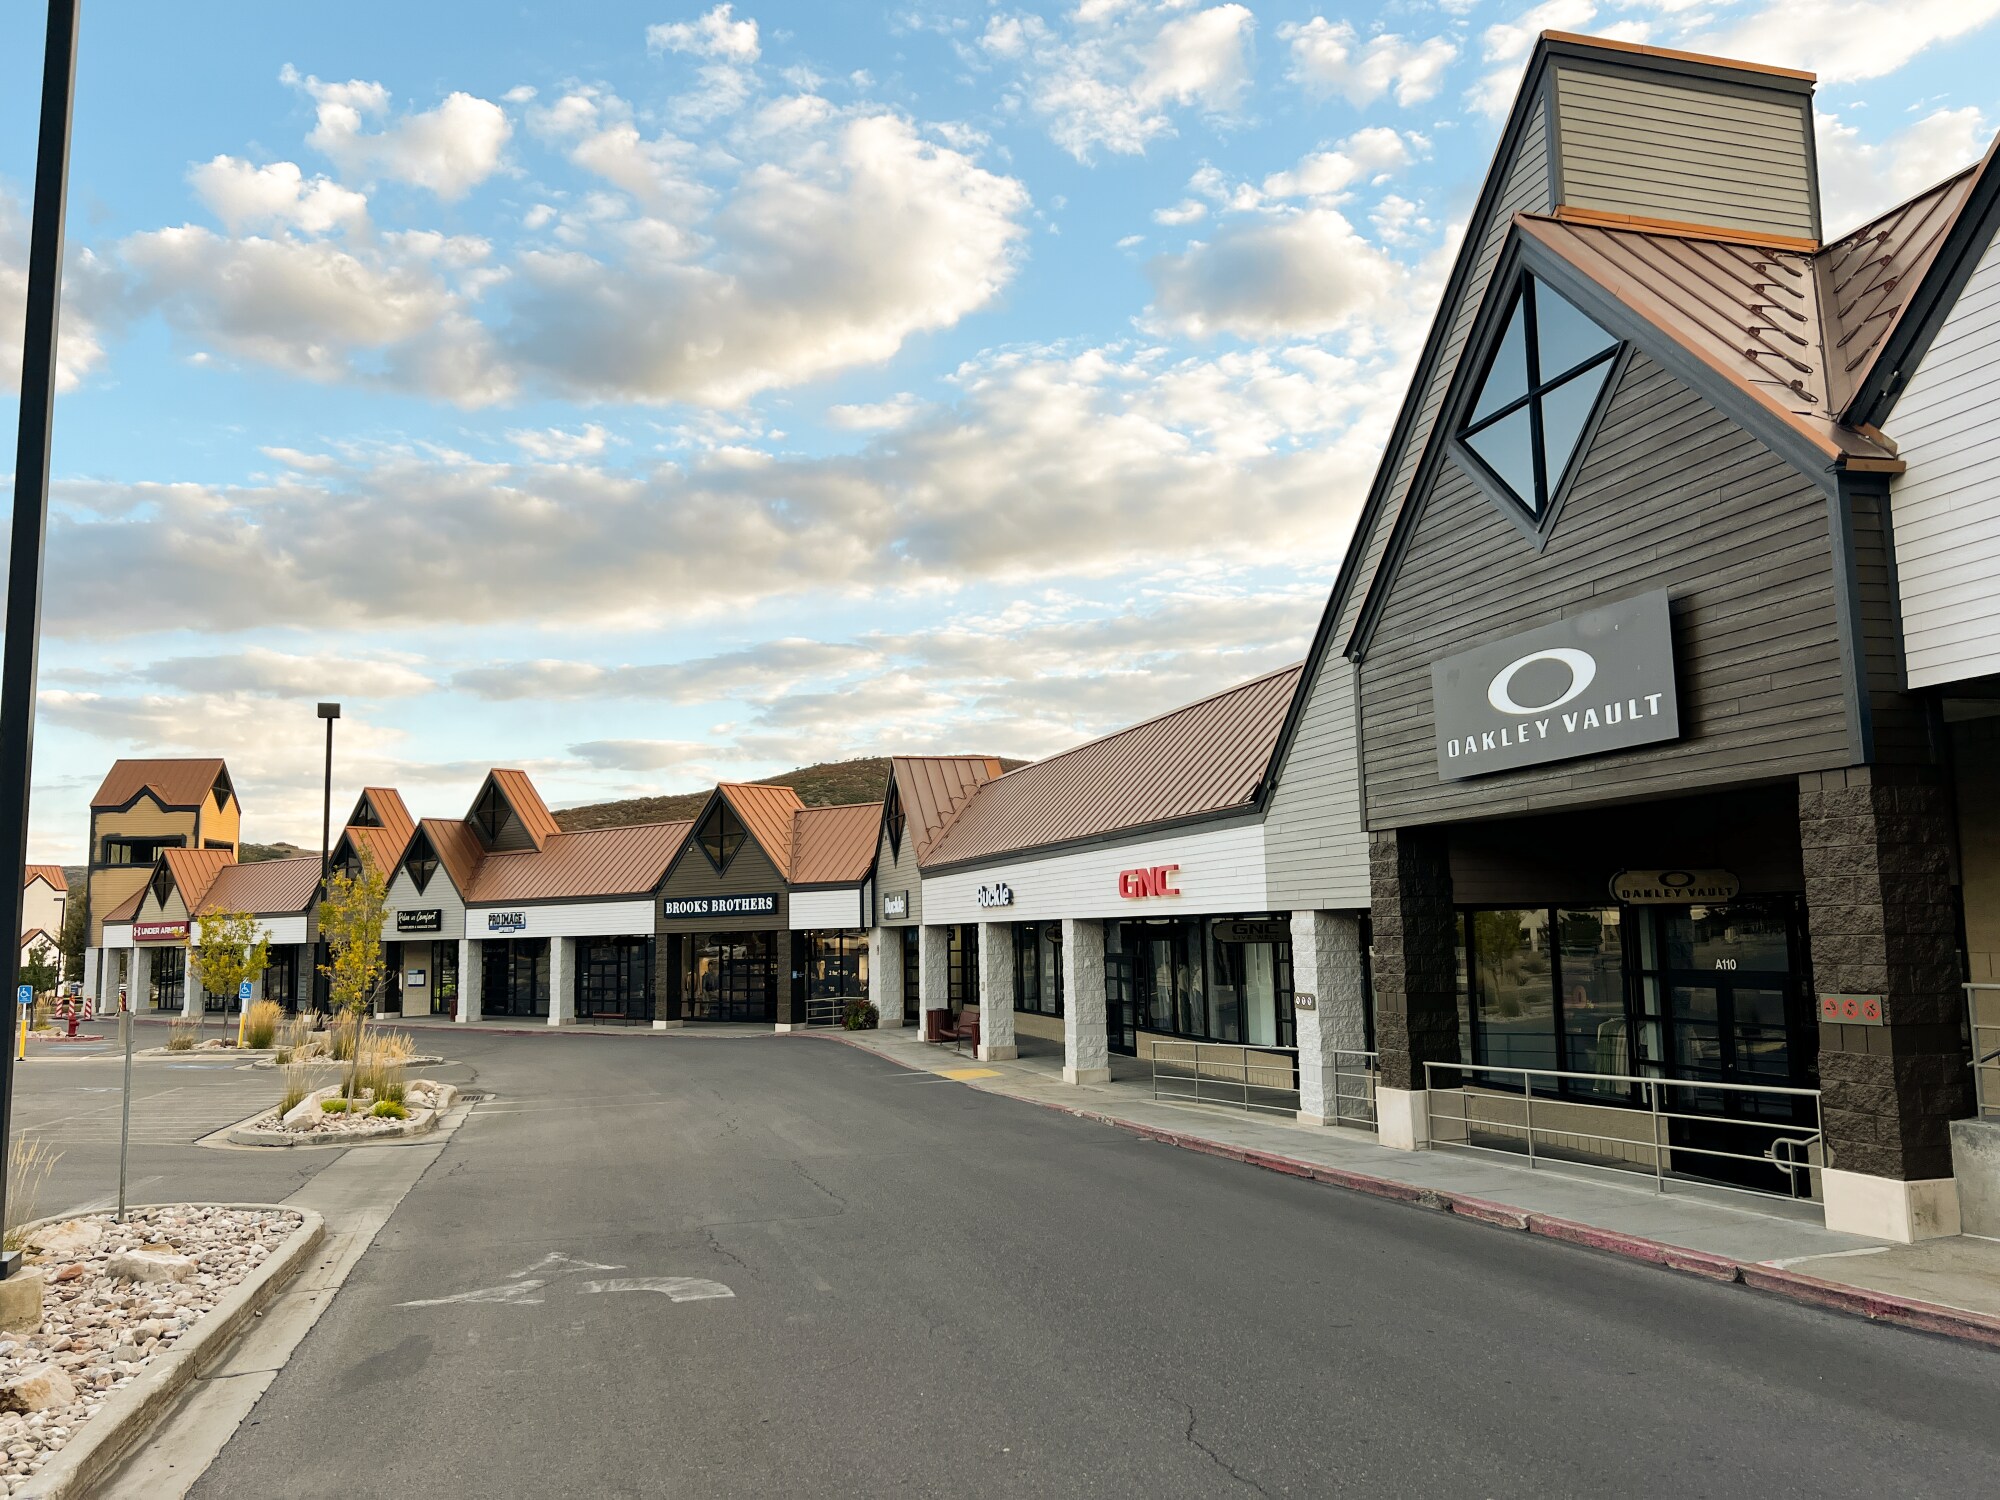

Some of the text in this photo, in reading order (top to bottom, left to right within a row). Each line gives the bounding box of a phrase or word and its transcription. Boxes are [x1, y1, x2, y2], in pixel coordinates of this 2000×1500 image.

[1447, 693, 1662, 758] OAKLEY VAULT
[1118, 864, 1180, 898] GNC
[976, 882, 1010, 907] Buckle
[1622, 887, 1733, 898] OAKLEY VAULT
[666, 897, 773, 914] BROOKS BROTHERS
[141, 927, 160, 935] UNDER
[1232, 923, 1280, 935] GNC
[1715, 958, 1737, 970] A110
